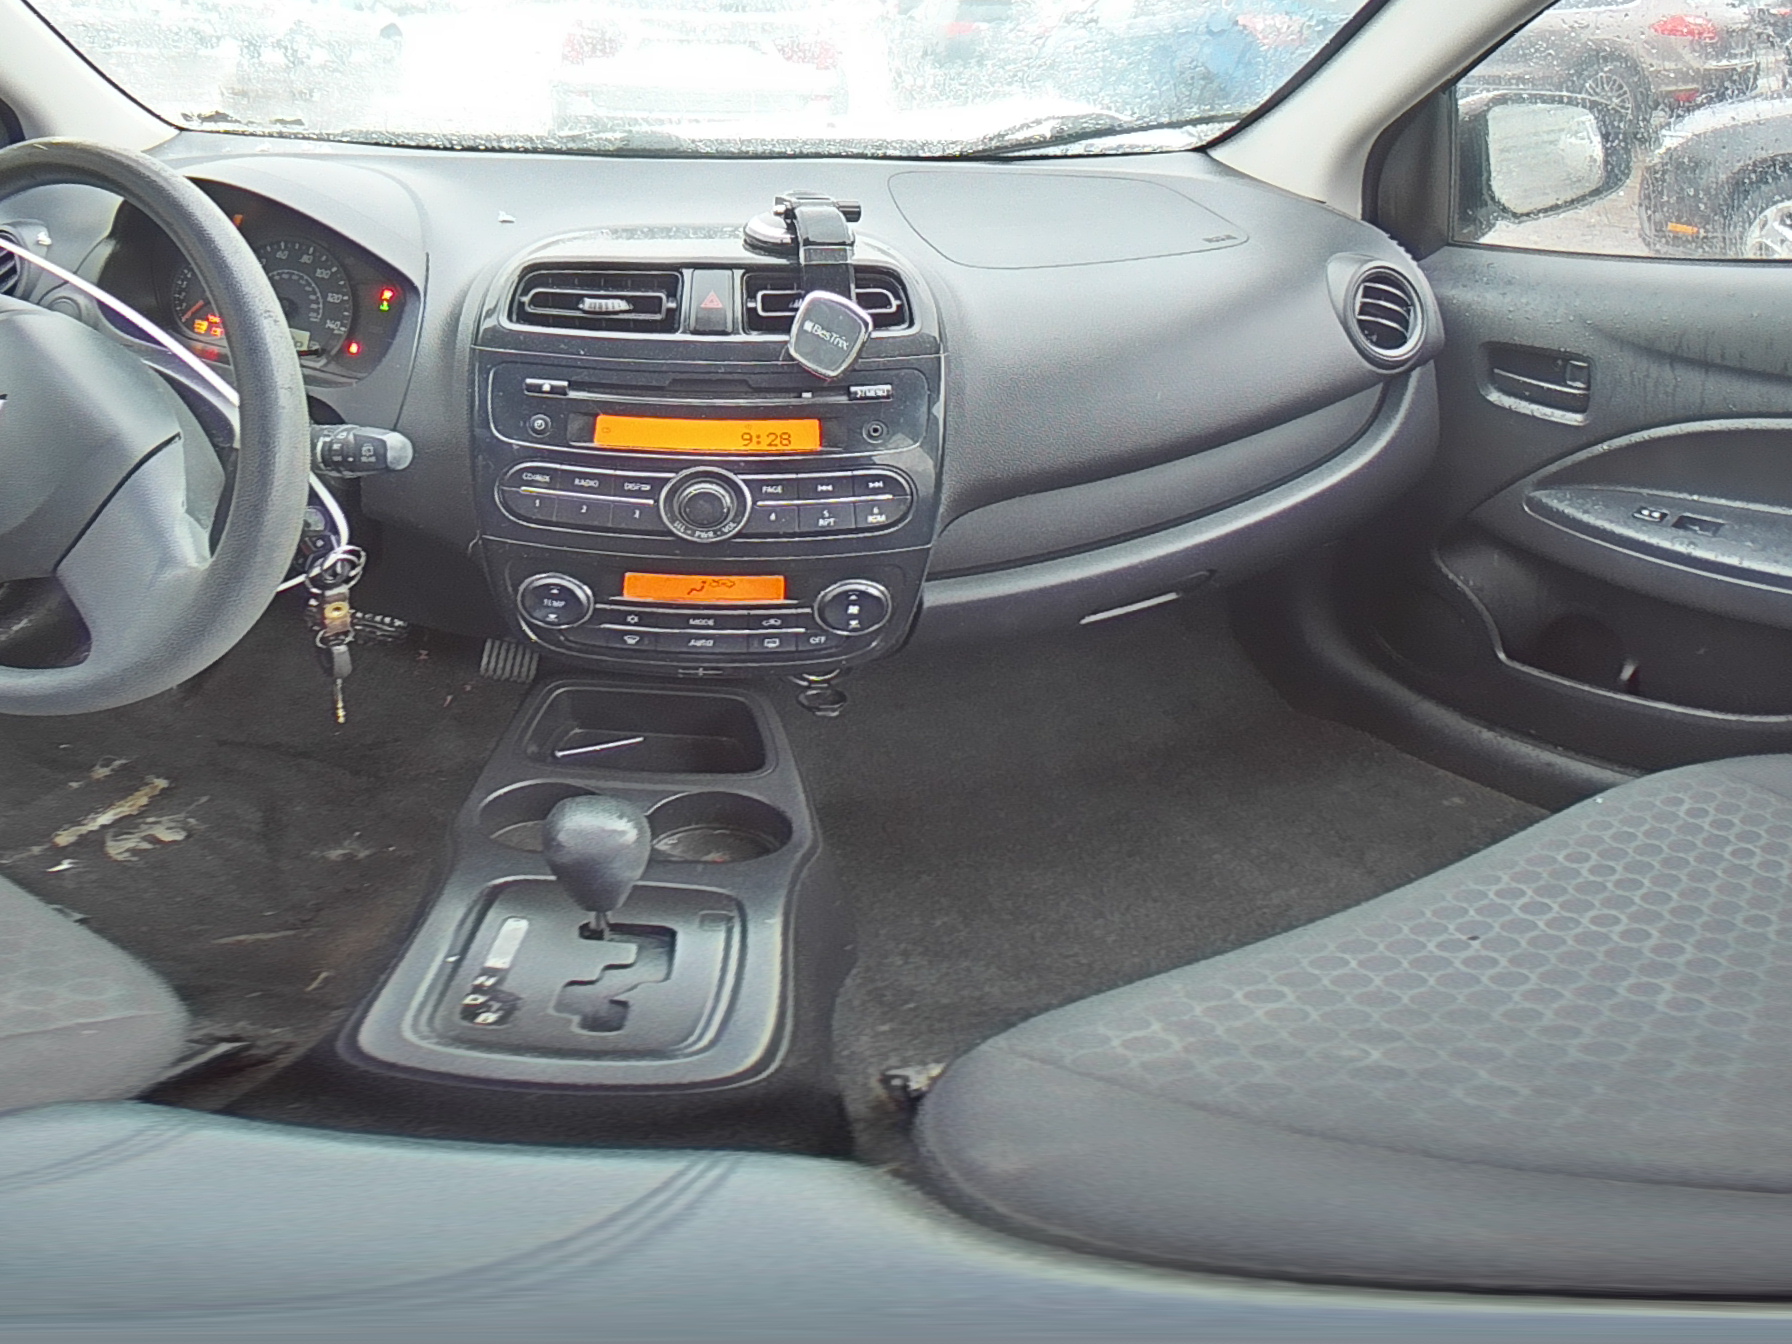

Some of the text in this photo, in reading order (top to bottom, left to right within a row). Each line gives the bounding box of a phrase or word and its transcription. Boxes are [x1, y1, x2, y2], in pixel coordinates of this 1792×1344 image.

[812, 323, 849, 351] BesTrix
[741, 432, 792, 447] 9:28
[574, 478, 600, 488] RADIO
[762, 485, 783, 494] PAGE
[580, 505, 588, 514] 2
[809, 636, 826, 645] OFF
